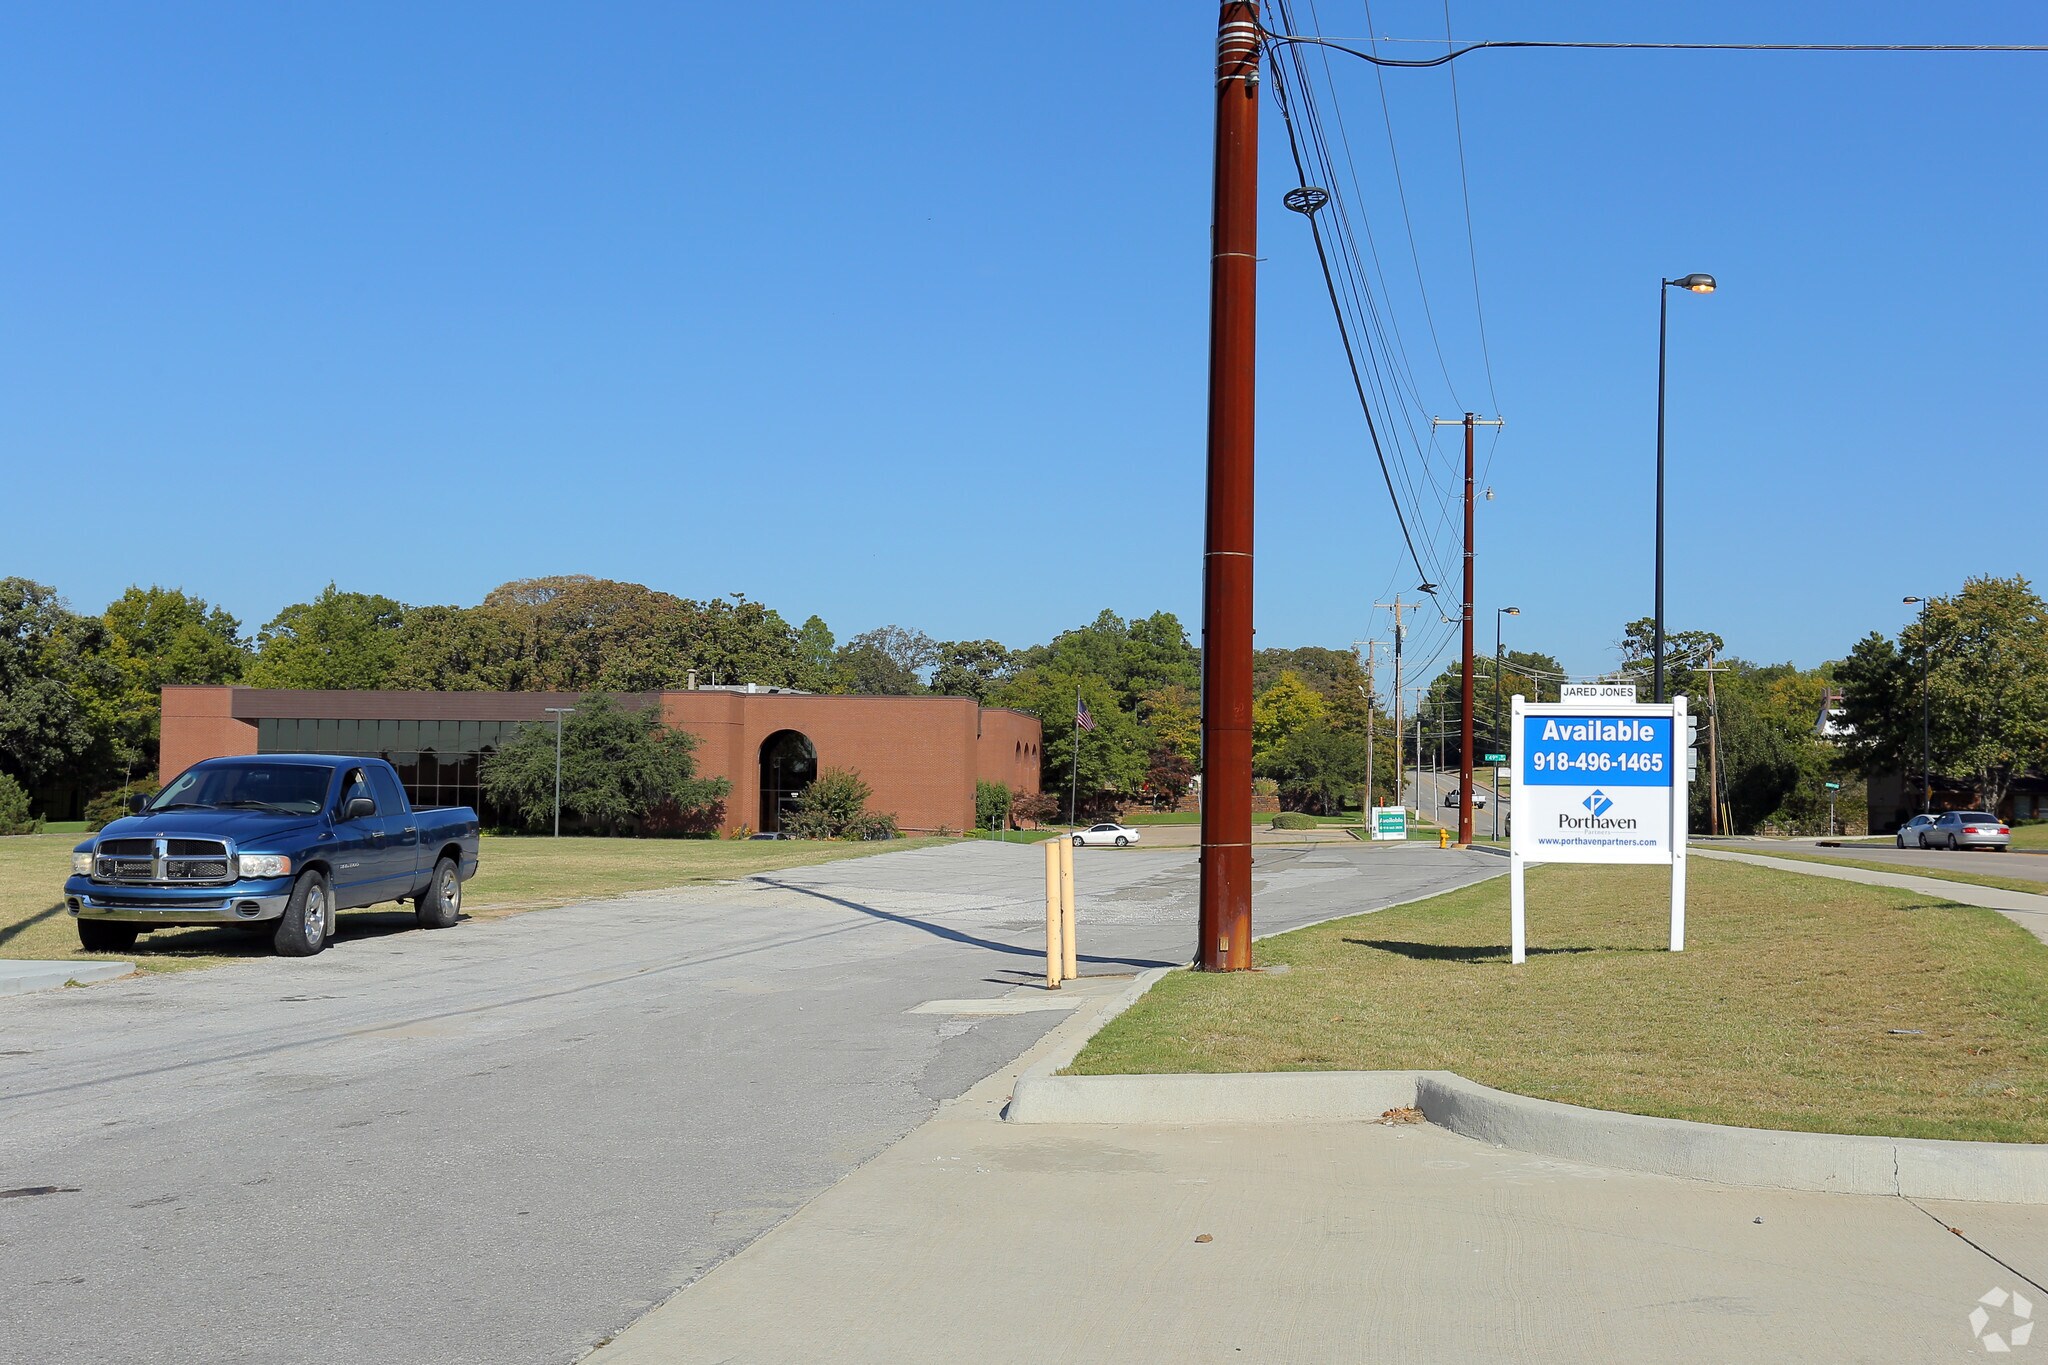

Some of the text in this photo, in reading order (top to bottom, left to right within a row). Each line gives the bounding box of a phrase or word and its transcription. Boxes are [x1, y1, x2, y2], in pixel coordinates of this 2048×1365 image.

[1563, 687, 1634, 697] JARED JONES
[1542, 719, 1655, 742] Available
[1533, 752, 1663, 772] 918-496-1465
[1559, 813, 1637, 829] Porthaven
[1538, 837, 1657, 847] www.porthavenpartners.com
